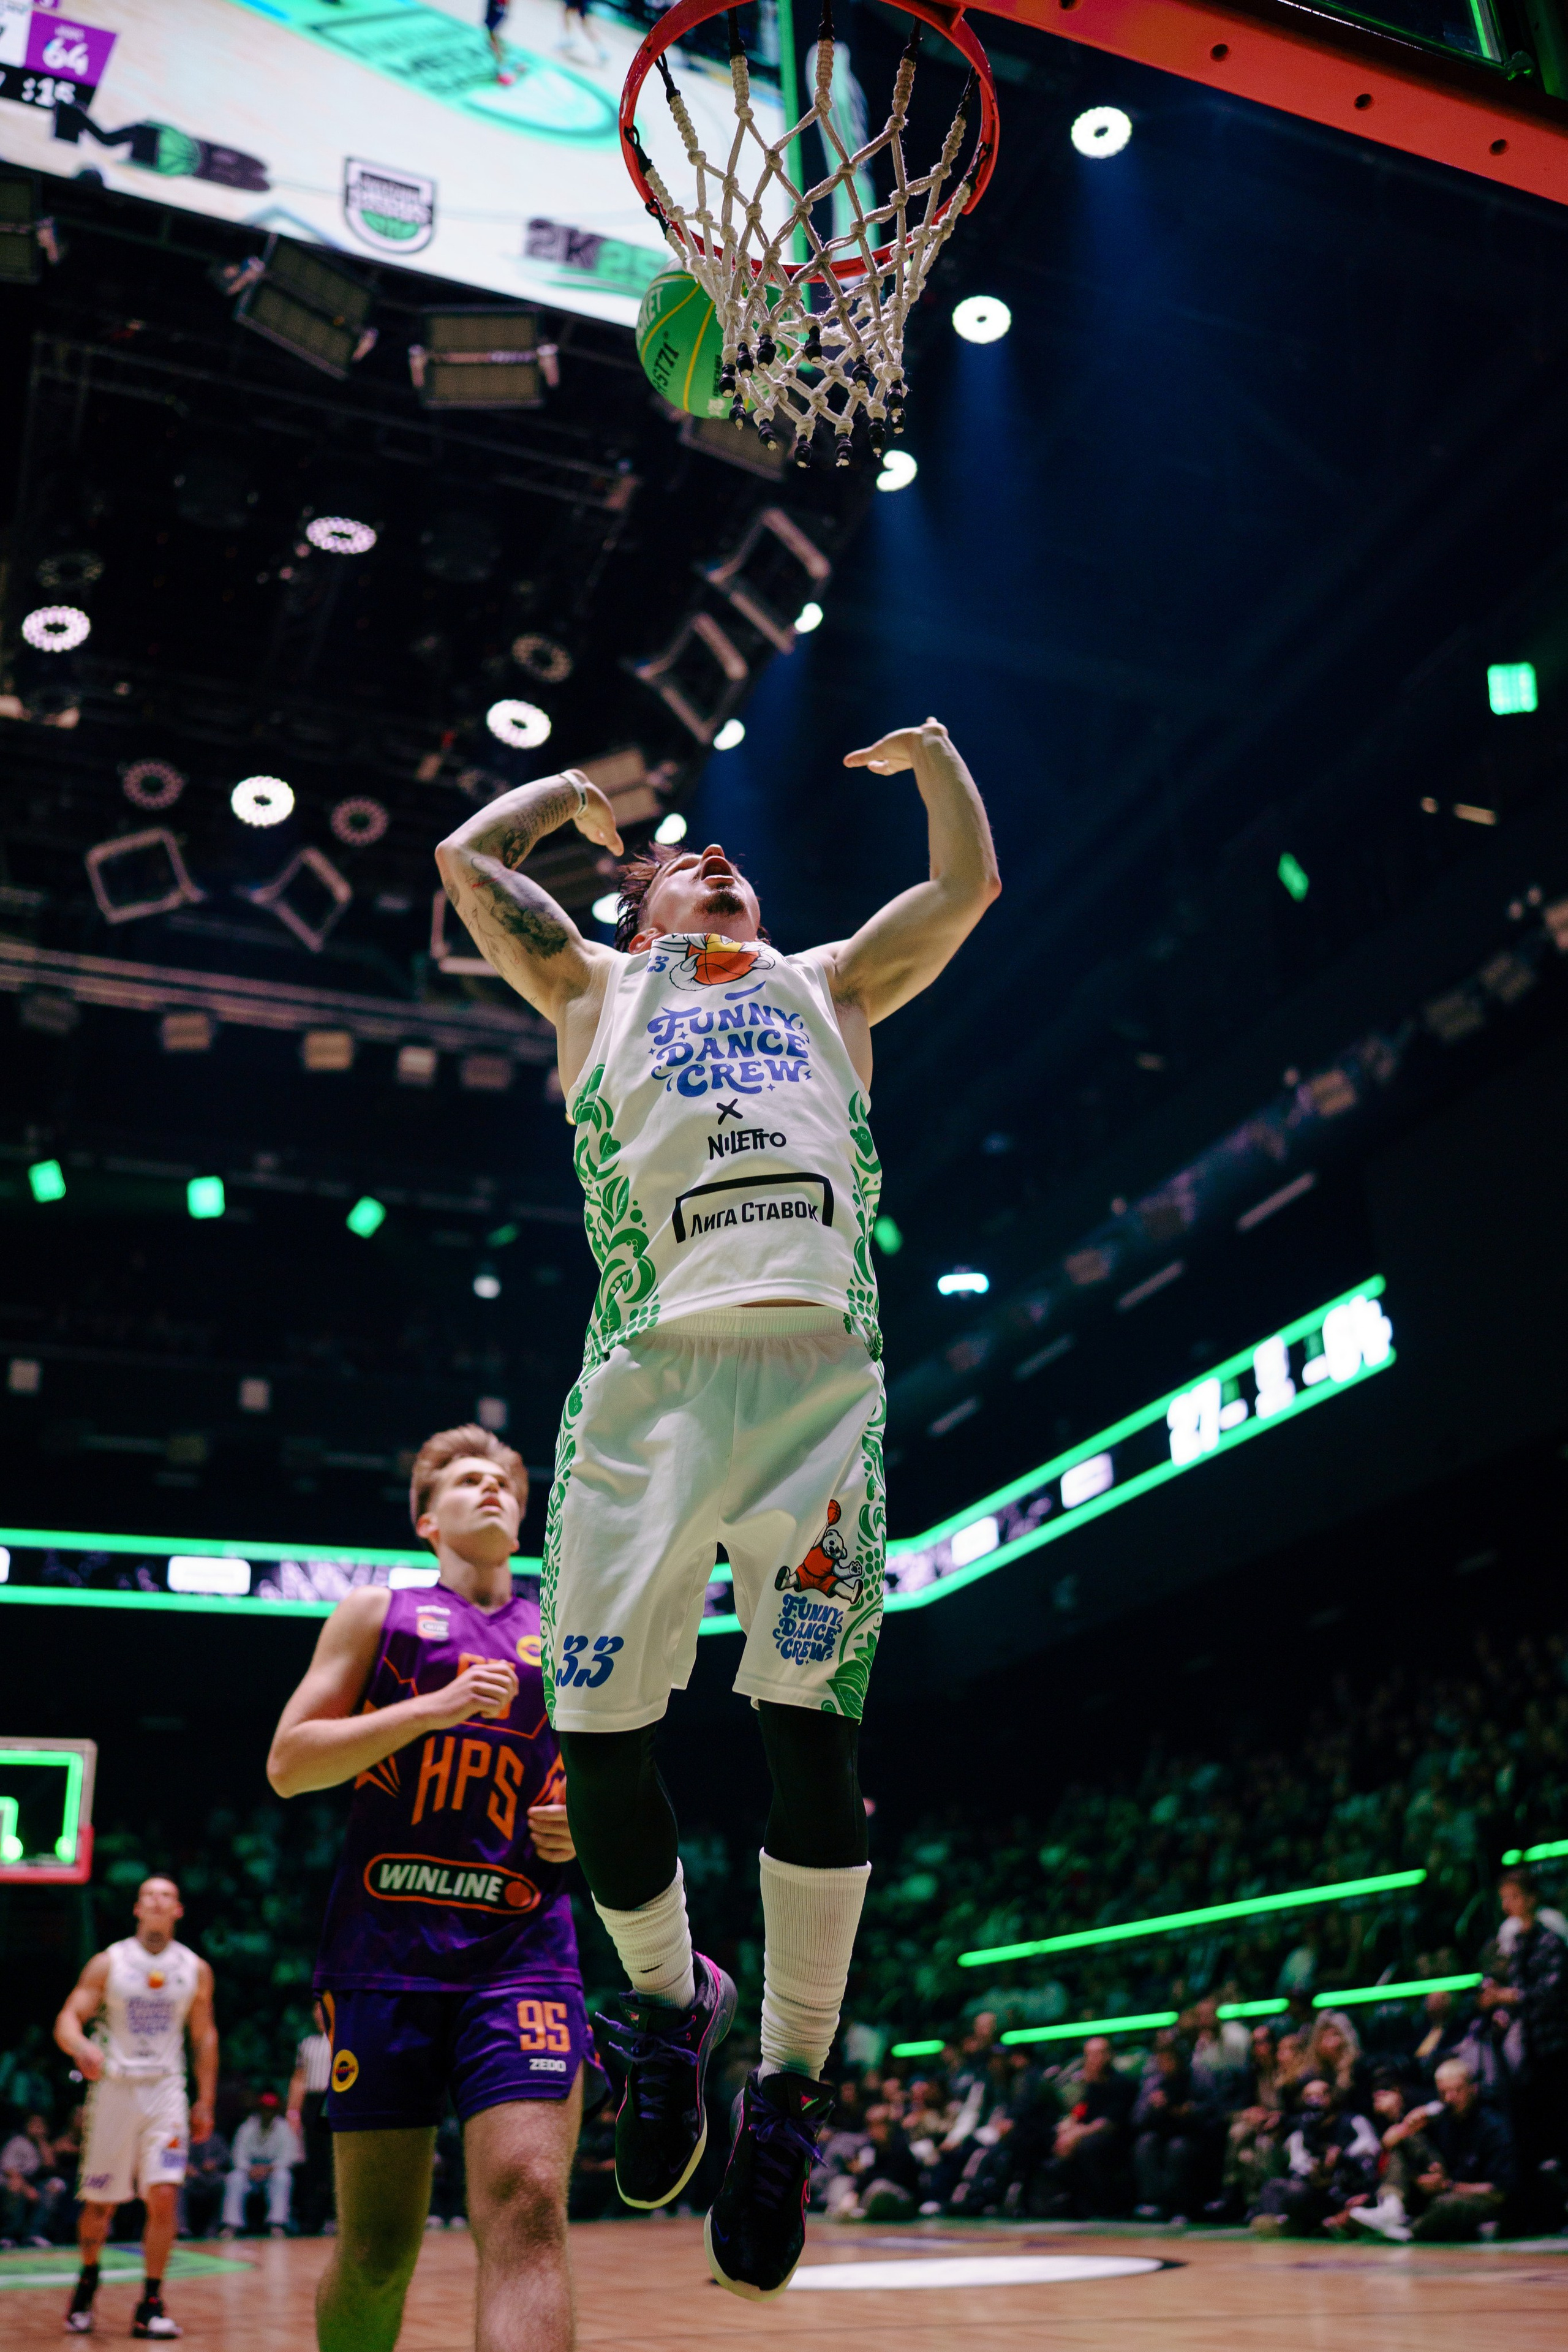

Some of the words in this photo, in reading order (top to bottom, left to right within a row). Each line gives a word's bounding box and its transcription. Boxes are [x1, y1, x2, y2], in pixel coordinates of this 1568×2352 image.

[42, 37, 89, 76] 64
[646, 956, 669, 973] 3
[647, 1003, 809, 1045] FUNNY
[656, 1029, 809, 1066] DANCE
[671, 1060, 809, 1097] CREW
[782, 1594, 843, 1626] FUNNY
[778, 1617, 837, 1646] DANCE
[556, 1635, 624, 1688] 33
[779, 1638, 833, 1665] CREW
[412, 1736, 524, 1841] HPS
[379, 1864, 503, 1902] WINLINE
[516, 2000, 571, 2052] 95
